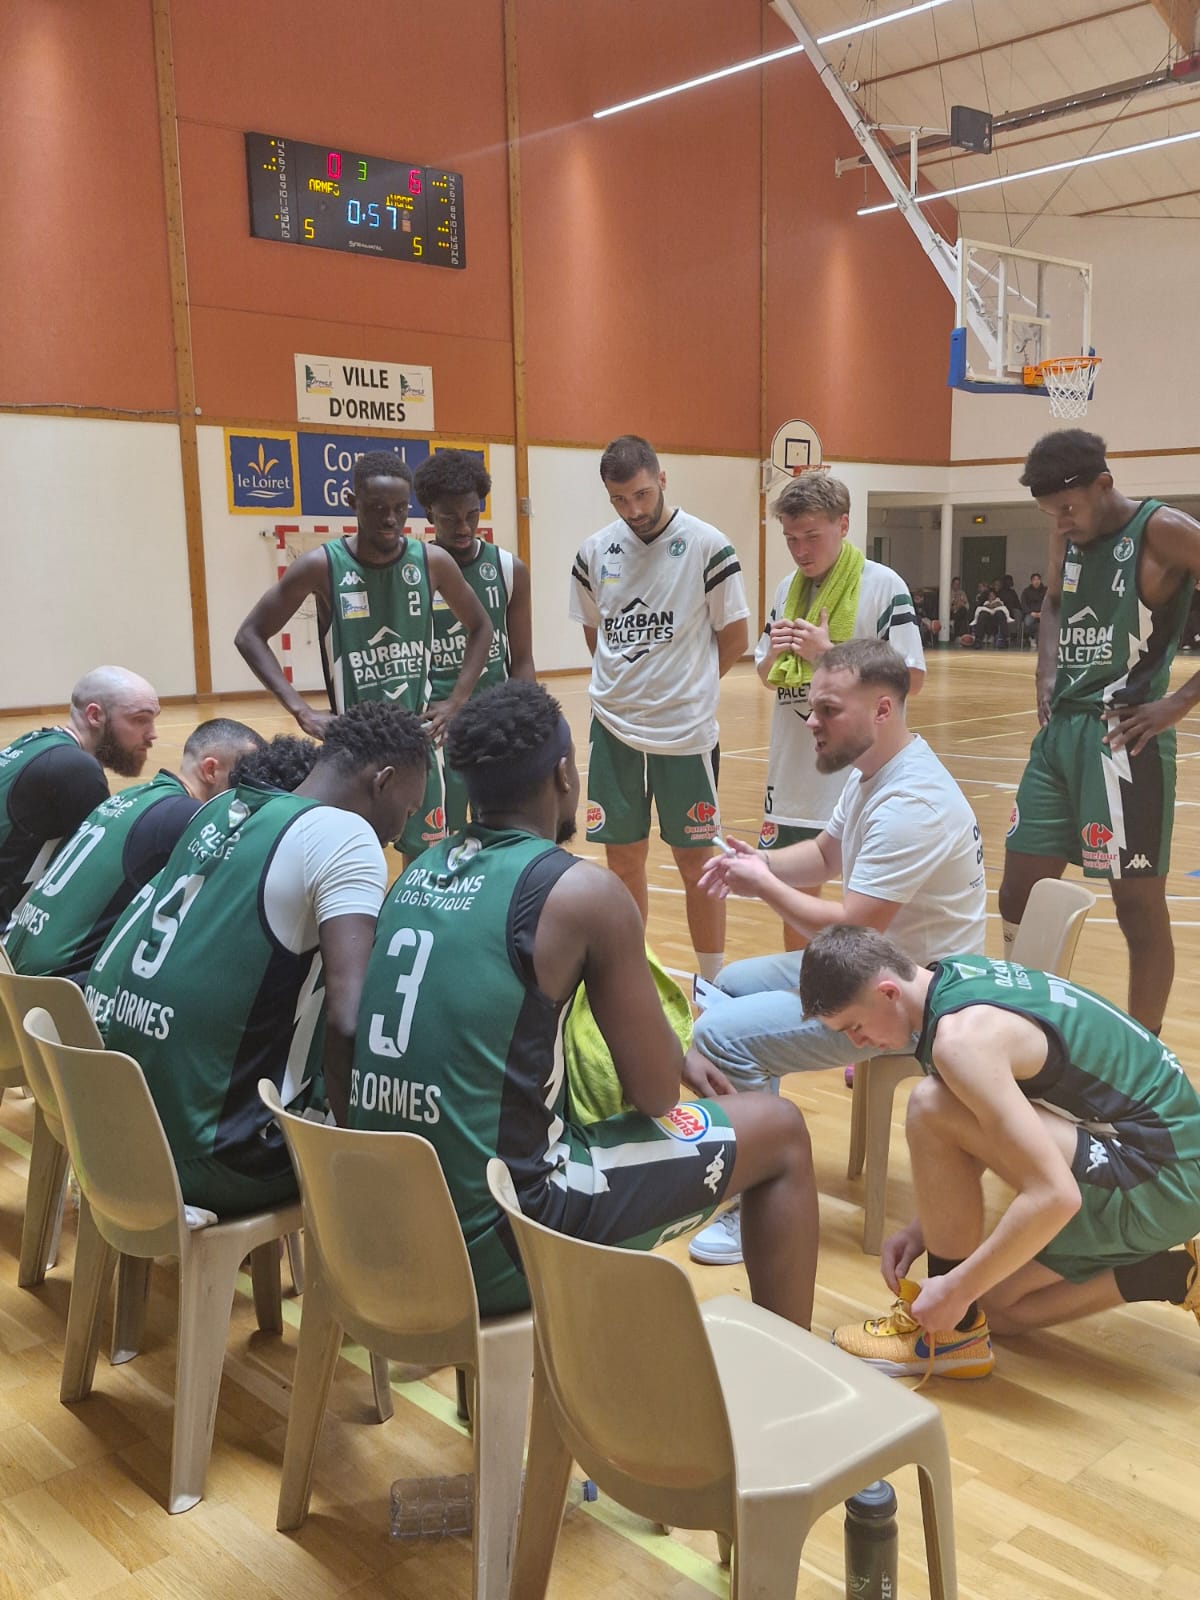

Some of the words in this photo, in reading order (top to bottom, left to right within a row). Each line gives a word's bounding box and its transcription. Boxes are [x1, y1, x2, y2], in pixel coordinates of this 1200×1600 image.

[327, 152, 342, 179] 0
[357, 161, 368, 182] 3
[408, 168, 422, 194] 6
[303, 218, 315, 239] 5
[413, 236, 423, 256] 5
[342, 365, 390, 390] VILLE
[328, 397, 406, 422] D'ORMES
[238, 473, 250, 488] le
[252, 474, 291, 489] Loiret
[1111, 568, 1126, 598] 4
[407, 590, 420, 616] 2
[485, 585, 500, 609] 11
[604, 611, 674, 632] BURBAN
[432, 628, 501, 653] BURN
[606, 626, 674, 645] PALETTES
[348, 640, 424, 670] BURBAN
[404, 868, 486, 893] ORLEANS
[395, 888, 476, 912] LOGISTIQUE
[367, 927, 434, 1060] 3
[115, 988, 175, 1040] ORMES
[361, 1070, 441, 1126] ORMES
